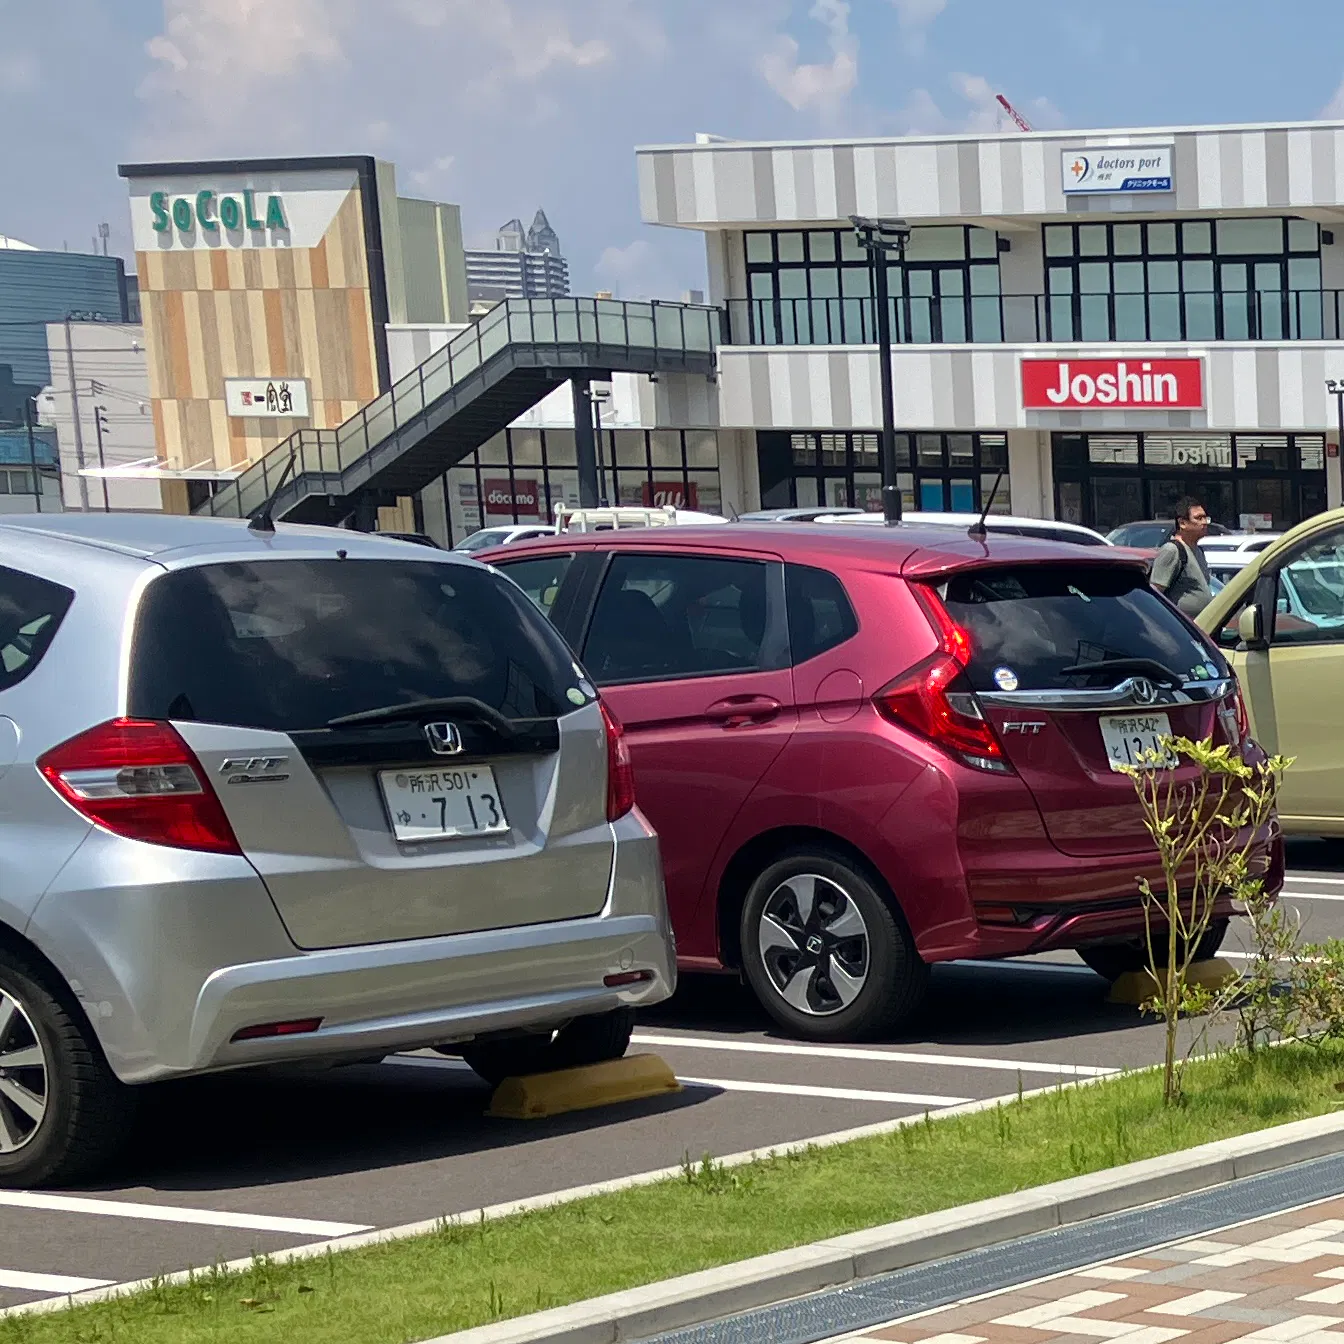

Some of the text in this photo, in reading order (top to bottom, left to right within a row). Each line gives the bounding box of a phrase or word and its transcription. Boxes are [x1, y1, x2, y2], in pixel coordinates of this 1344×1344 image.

[1097, 156, 1162, 172] doctors port
[1127, 180, 1168, 188] クリニックモール
[1046, 363, 1178, 404] Joshin
[653, 490, 686, 509] au
[1002, 721, 1046, 735] FIT
